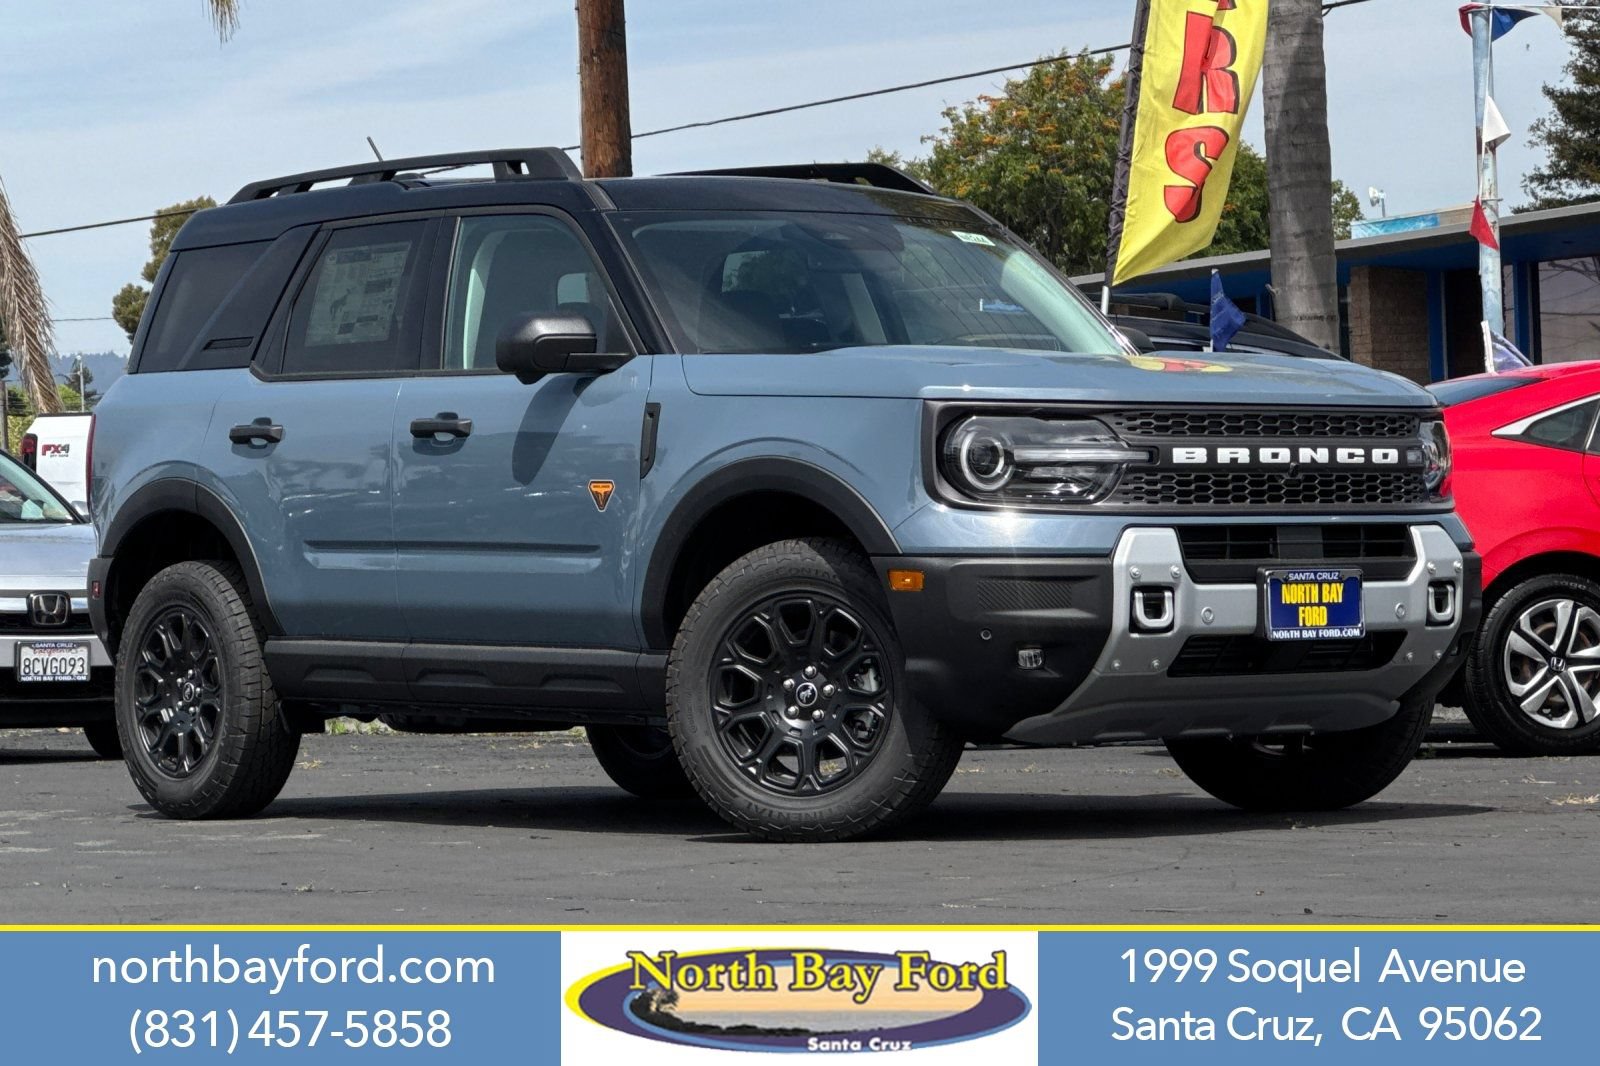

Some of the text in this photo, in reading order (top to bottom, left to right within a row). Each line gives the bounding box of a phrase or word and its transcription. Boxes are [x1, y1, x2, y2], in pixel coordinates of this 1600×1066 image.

[1163, 0, 1240, 223] RS
[41, 444, 70, 456] FX4
[1172, 447, 1399, 464] BRONCO
[1288, 571, 1339, 581] SANTA CRUZ
[1281, 582, 1344, 604] NORTH BAY
[1298, 605, 1328, 627] FORD
[1272, 628, 1360, 639] NORTH BAY FORD.COM
[23, 657, 85, 675] 8CVG093
